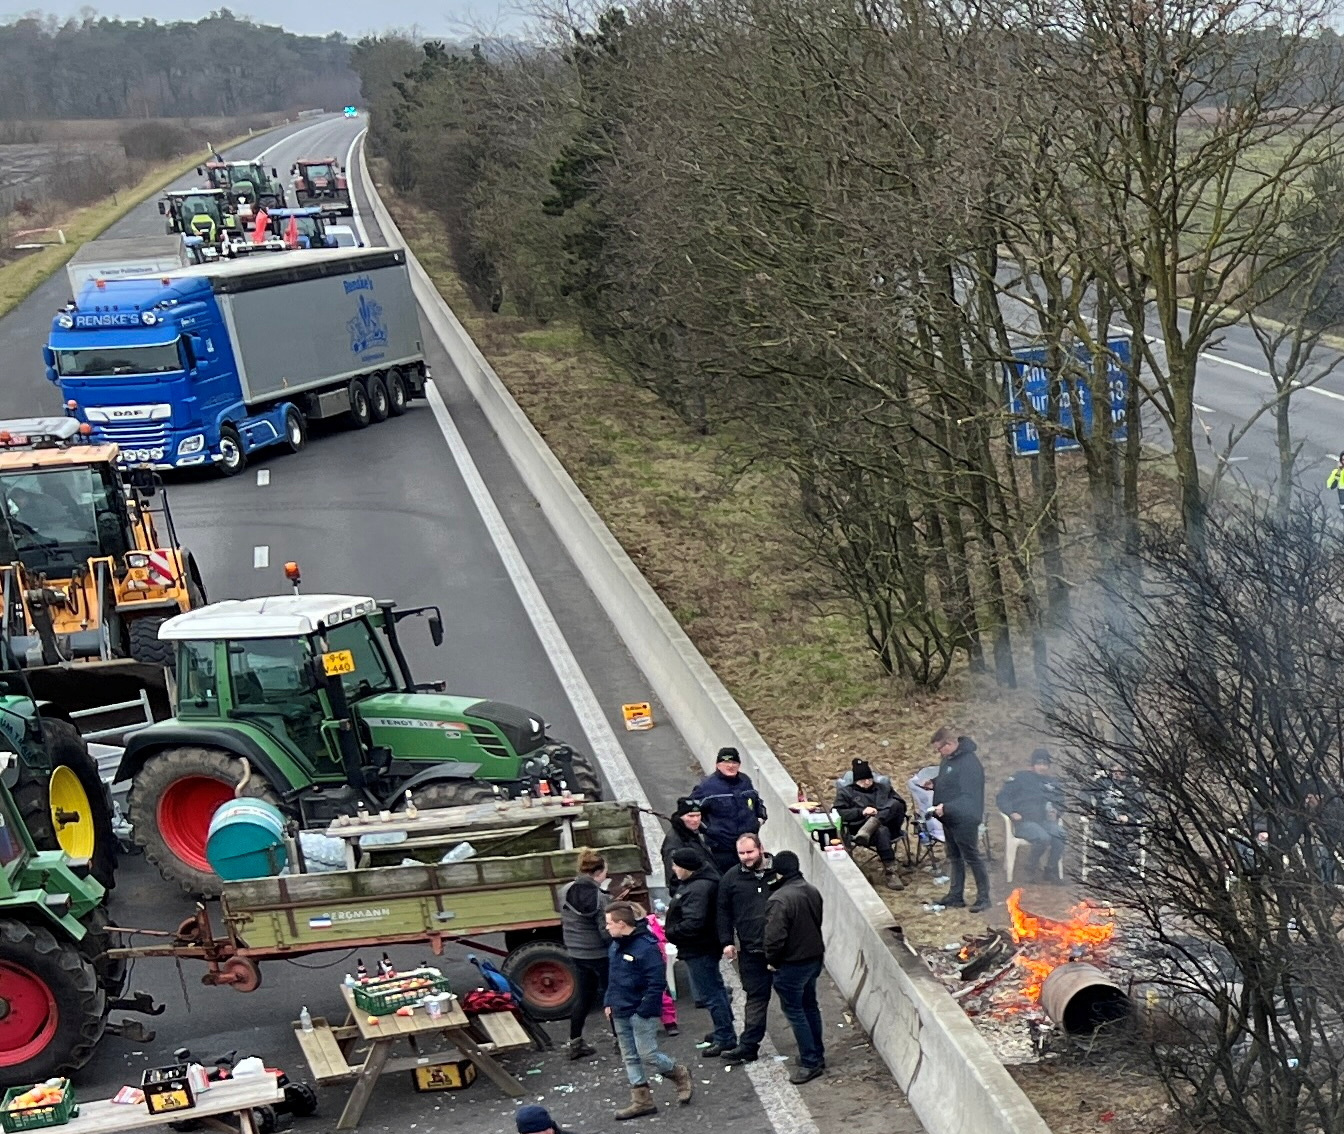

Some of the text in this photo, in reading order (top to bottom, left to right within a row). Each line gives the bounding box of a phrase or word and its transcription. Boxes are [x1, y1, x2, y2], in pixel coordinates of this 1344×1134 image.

[76, 313, 139, 327] RENSKE'S
[113, 409, 143, 417] DAF
[380, 719, 414, 727] FENDT
